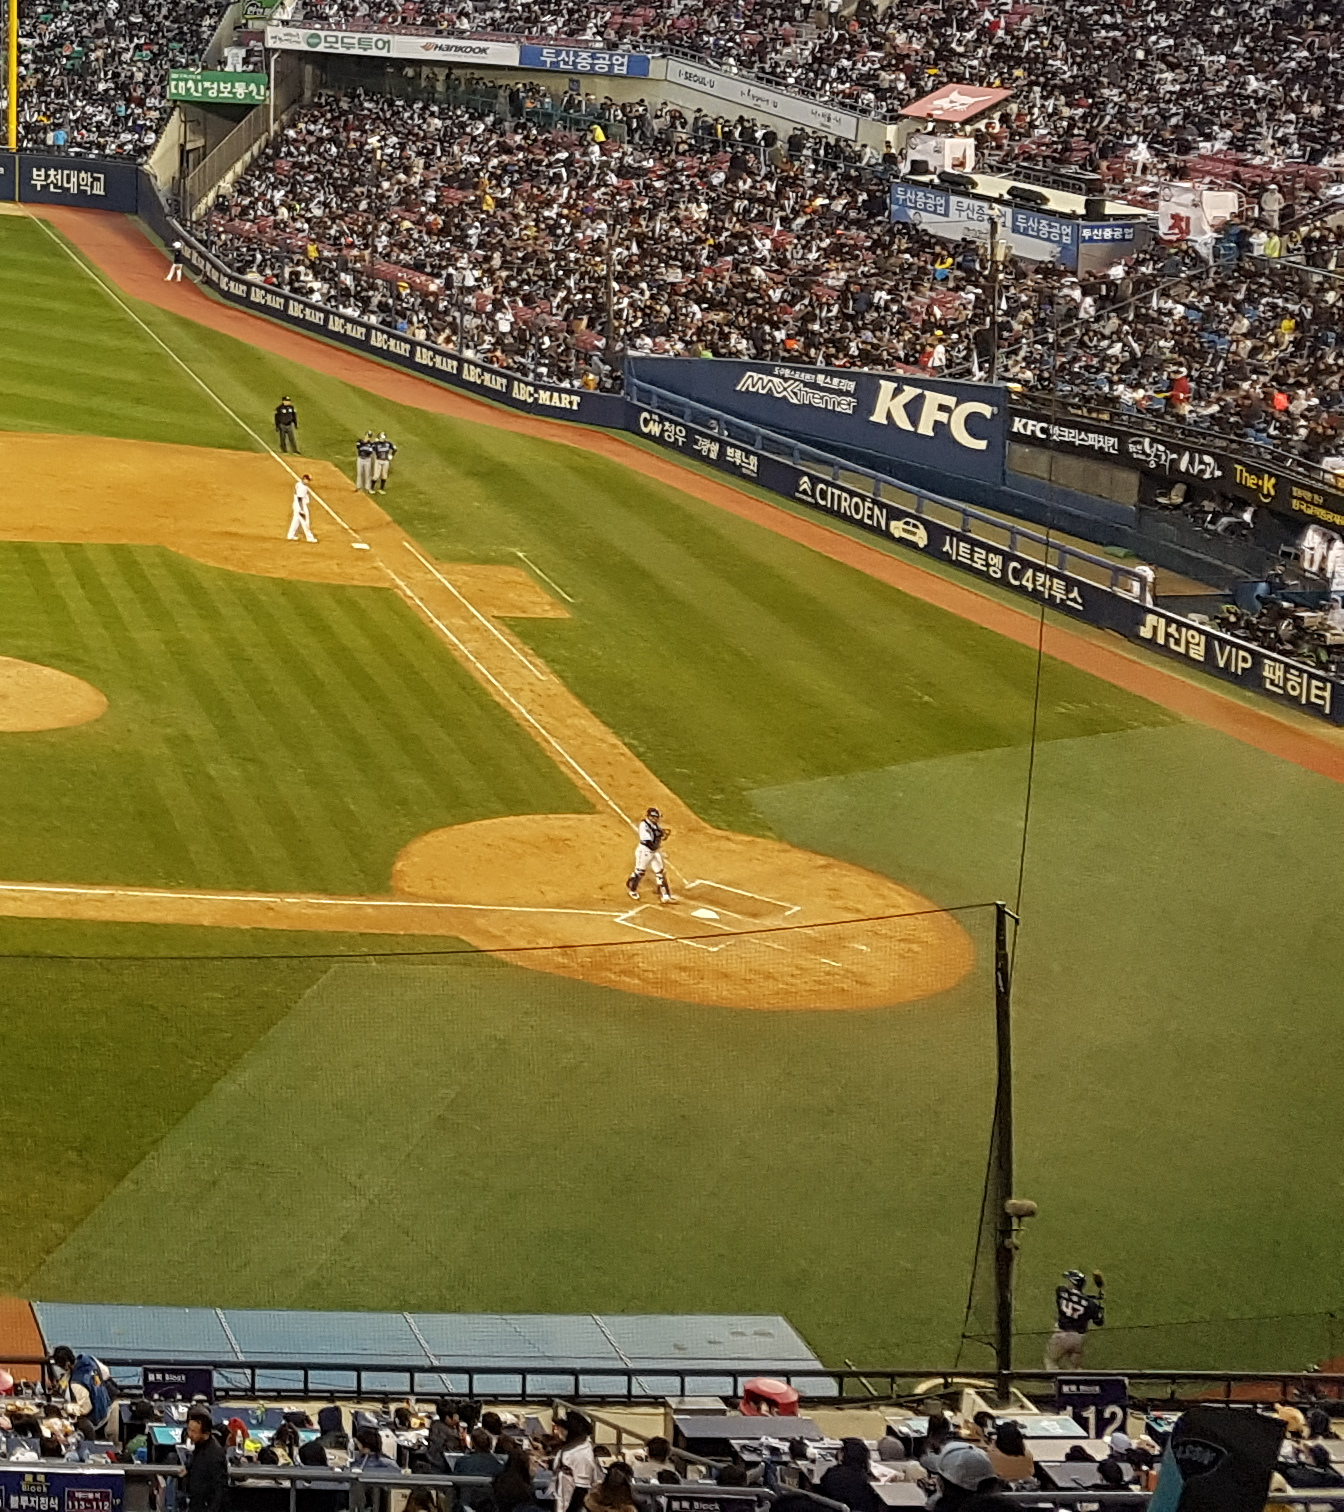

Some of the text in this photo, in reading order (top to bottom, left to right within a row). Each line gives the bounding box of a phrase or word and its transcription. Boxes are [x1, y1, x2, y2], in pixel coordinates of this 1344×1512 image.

[323, 34, 392, 54] 모두투어
[540, 48, 629, 76] 두산중공업
[170, 78, 266, 101] 대신정보통신
[30, 166, 106, 196] 부천대학교
[895, 187, 946, 215] 두산중공업
[1015, 211, 1072, 243] 두산중공업
[1081, 225, 1134, 240] 두산중공업
[288, 299, 324, 326] ABC-MART
[328, 314, 366, 342] ABC-MART
[370, 329, 410, 358] ABC-MART
[415, 345, 458, 375] ABC-MART
[463, 362, 507, 393] ABC-MART
[513, 381, 581, 410] ABC-MART
[869, 379, 994, 451] KFC
[1011, 416, 1049, 439] KFC
[663, 421, 687, 446] 청우
[815, 482, 887, 532] CITROËN
[942, 534, 1003, 579] 시트로엥
[1168, 621, 1332, 714] 신일 VIP 팬히터
